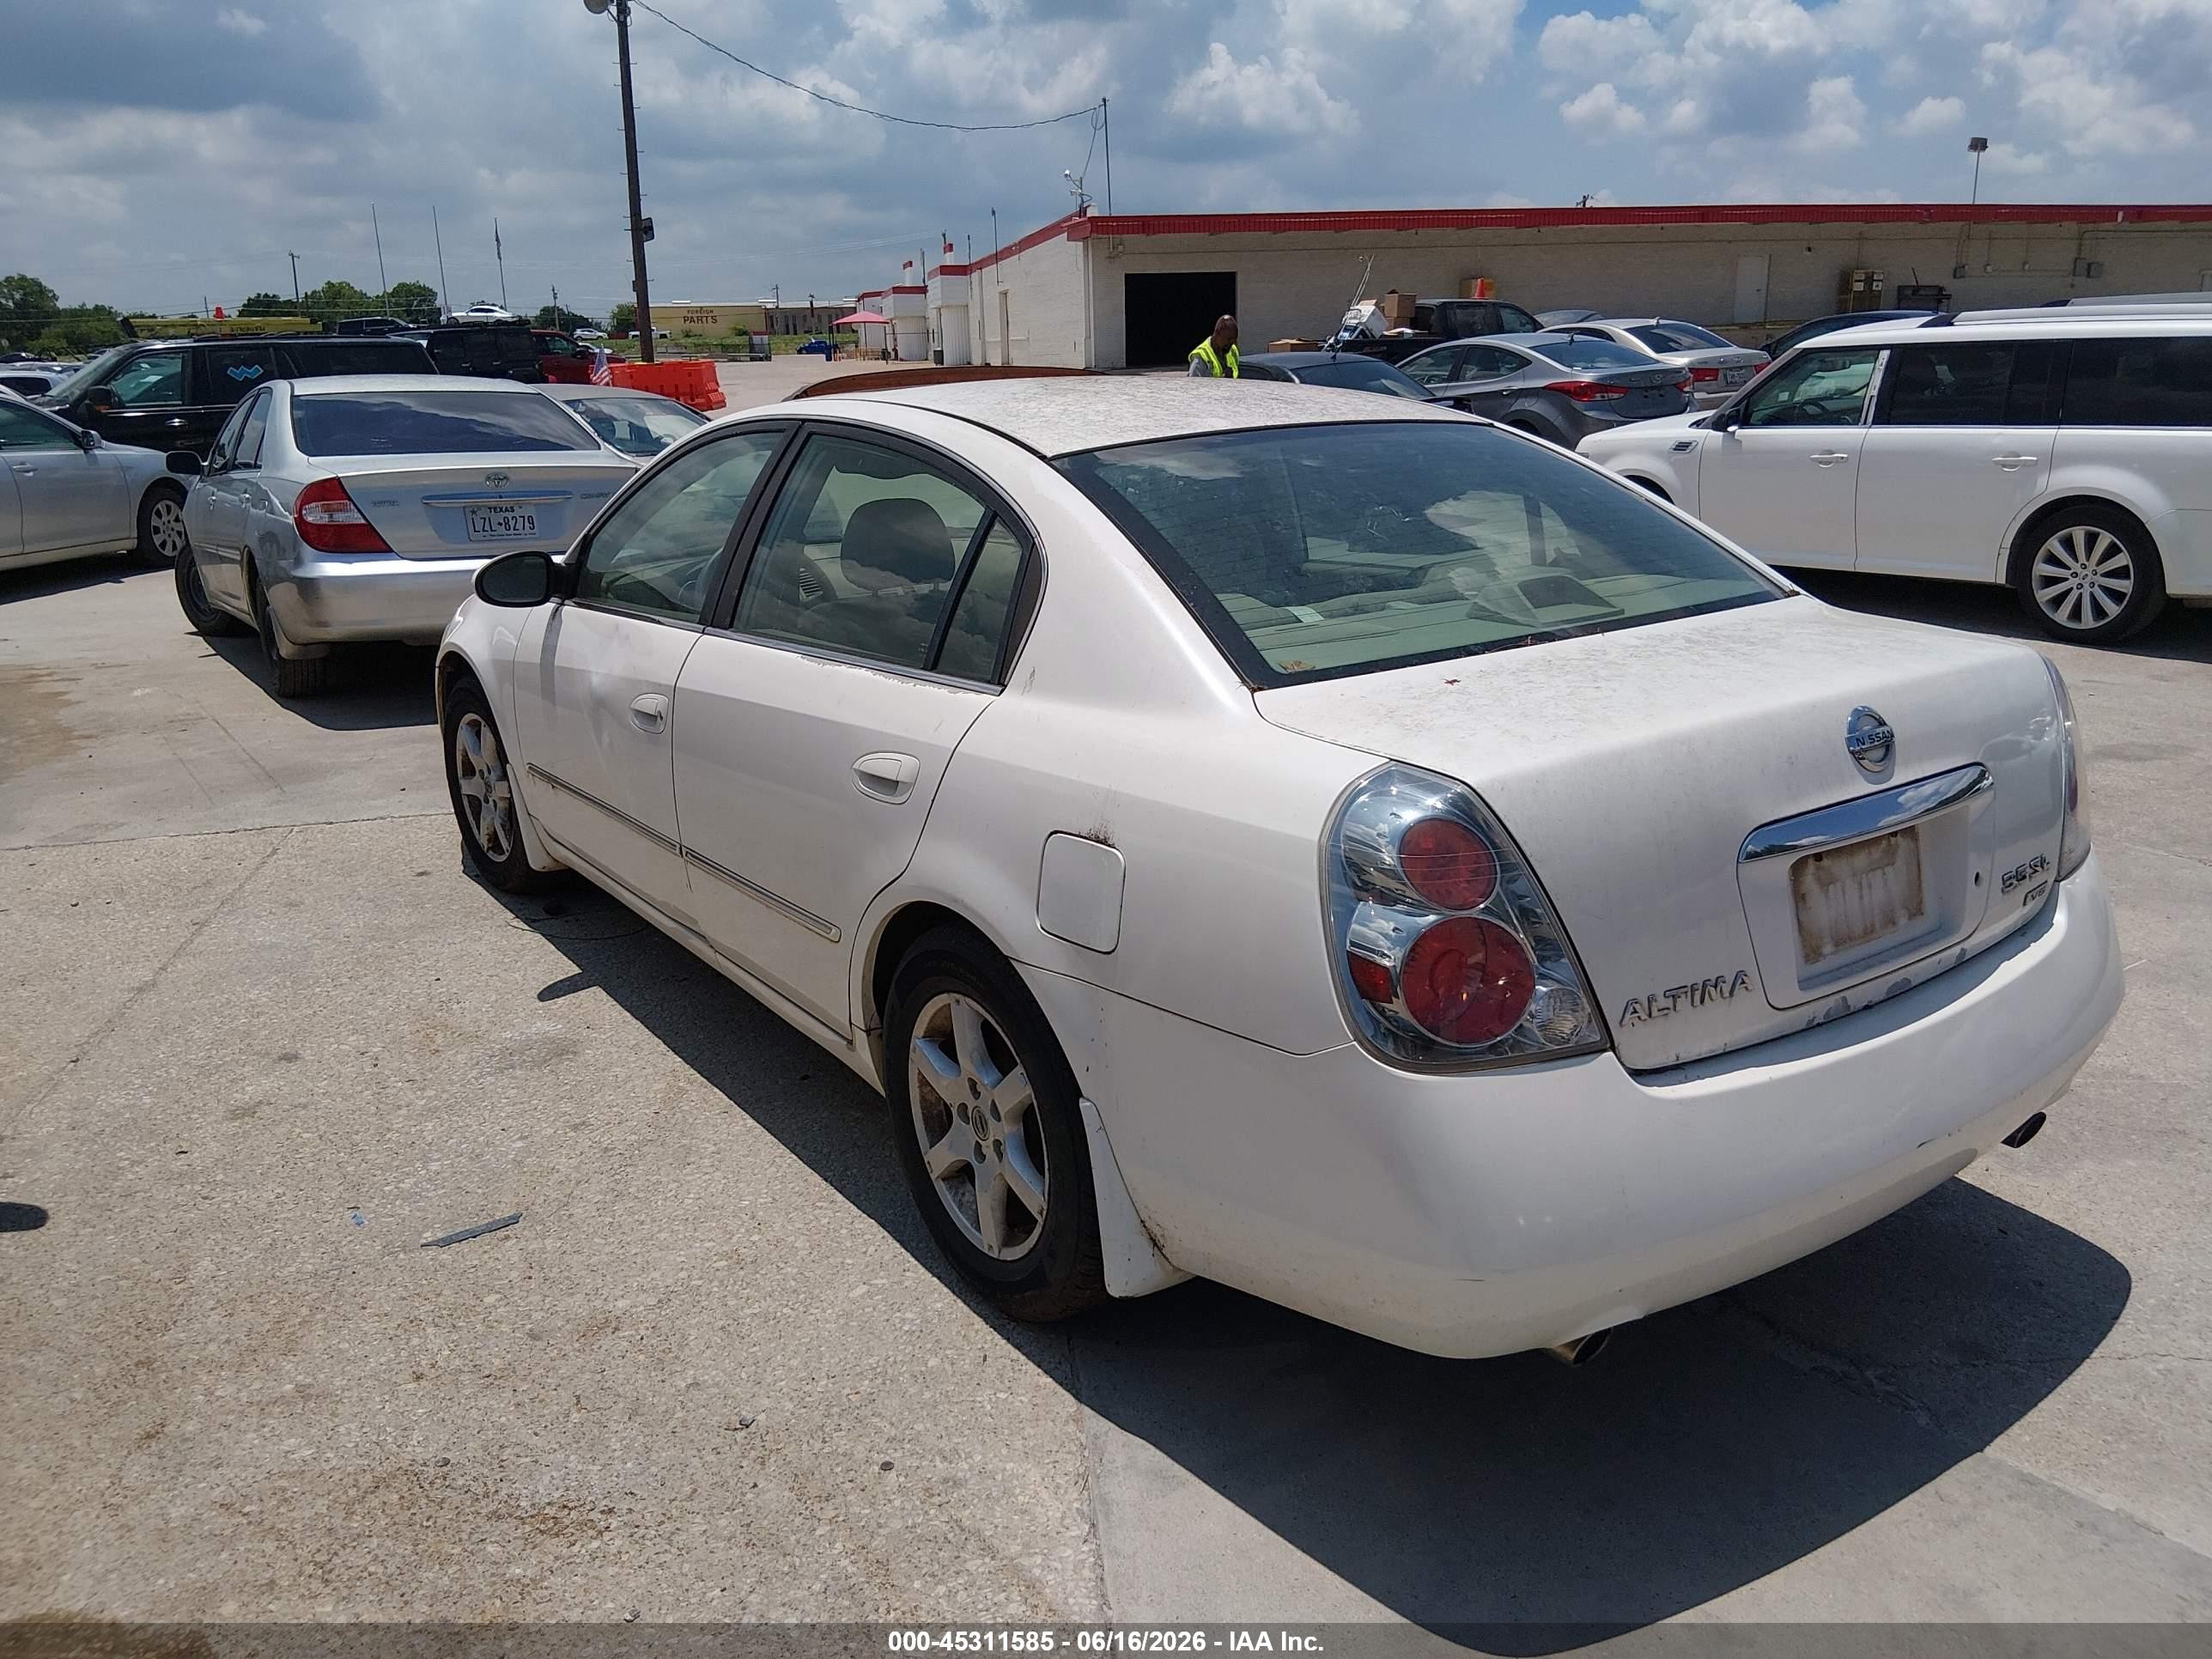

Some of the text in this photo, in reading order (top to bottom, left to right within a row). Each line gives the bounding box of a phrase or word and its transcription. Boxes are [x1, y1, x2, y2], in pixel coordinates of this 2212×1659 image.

[684, 315, 718, 324] PARTS
[1855, 730, 1894, 747] NSSAN
[1619, 969, 1753, 1028] ALTIMA
